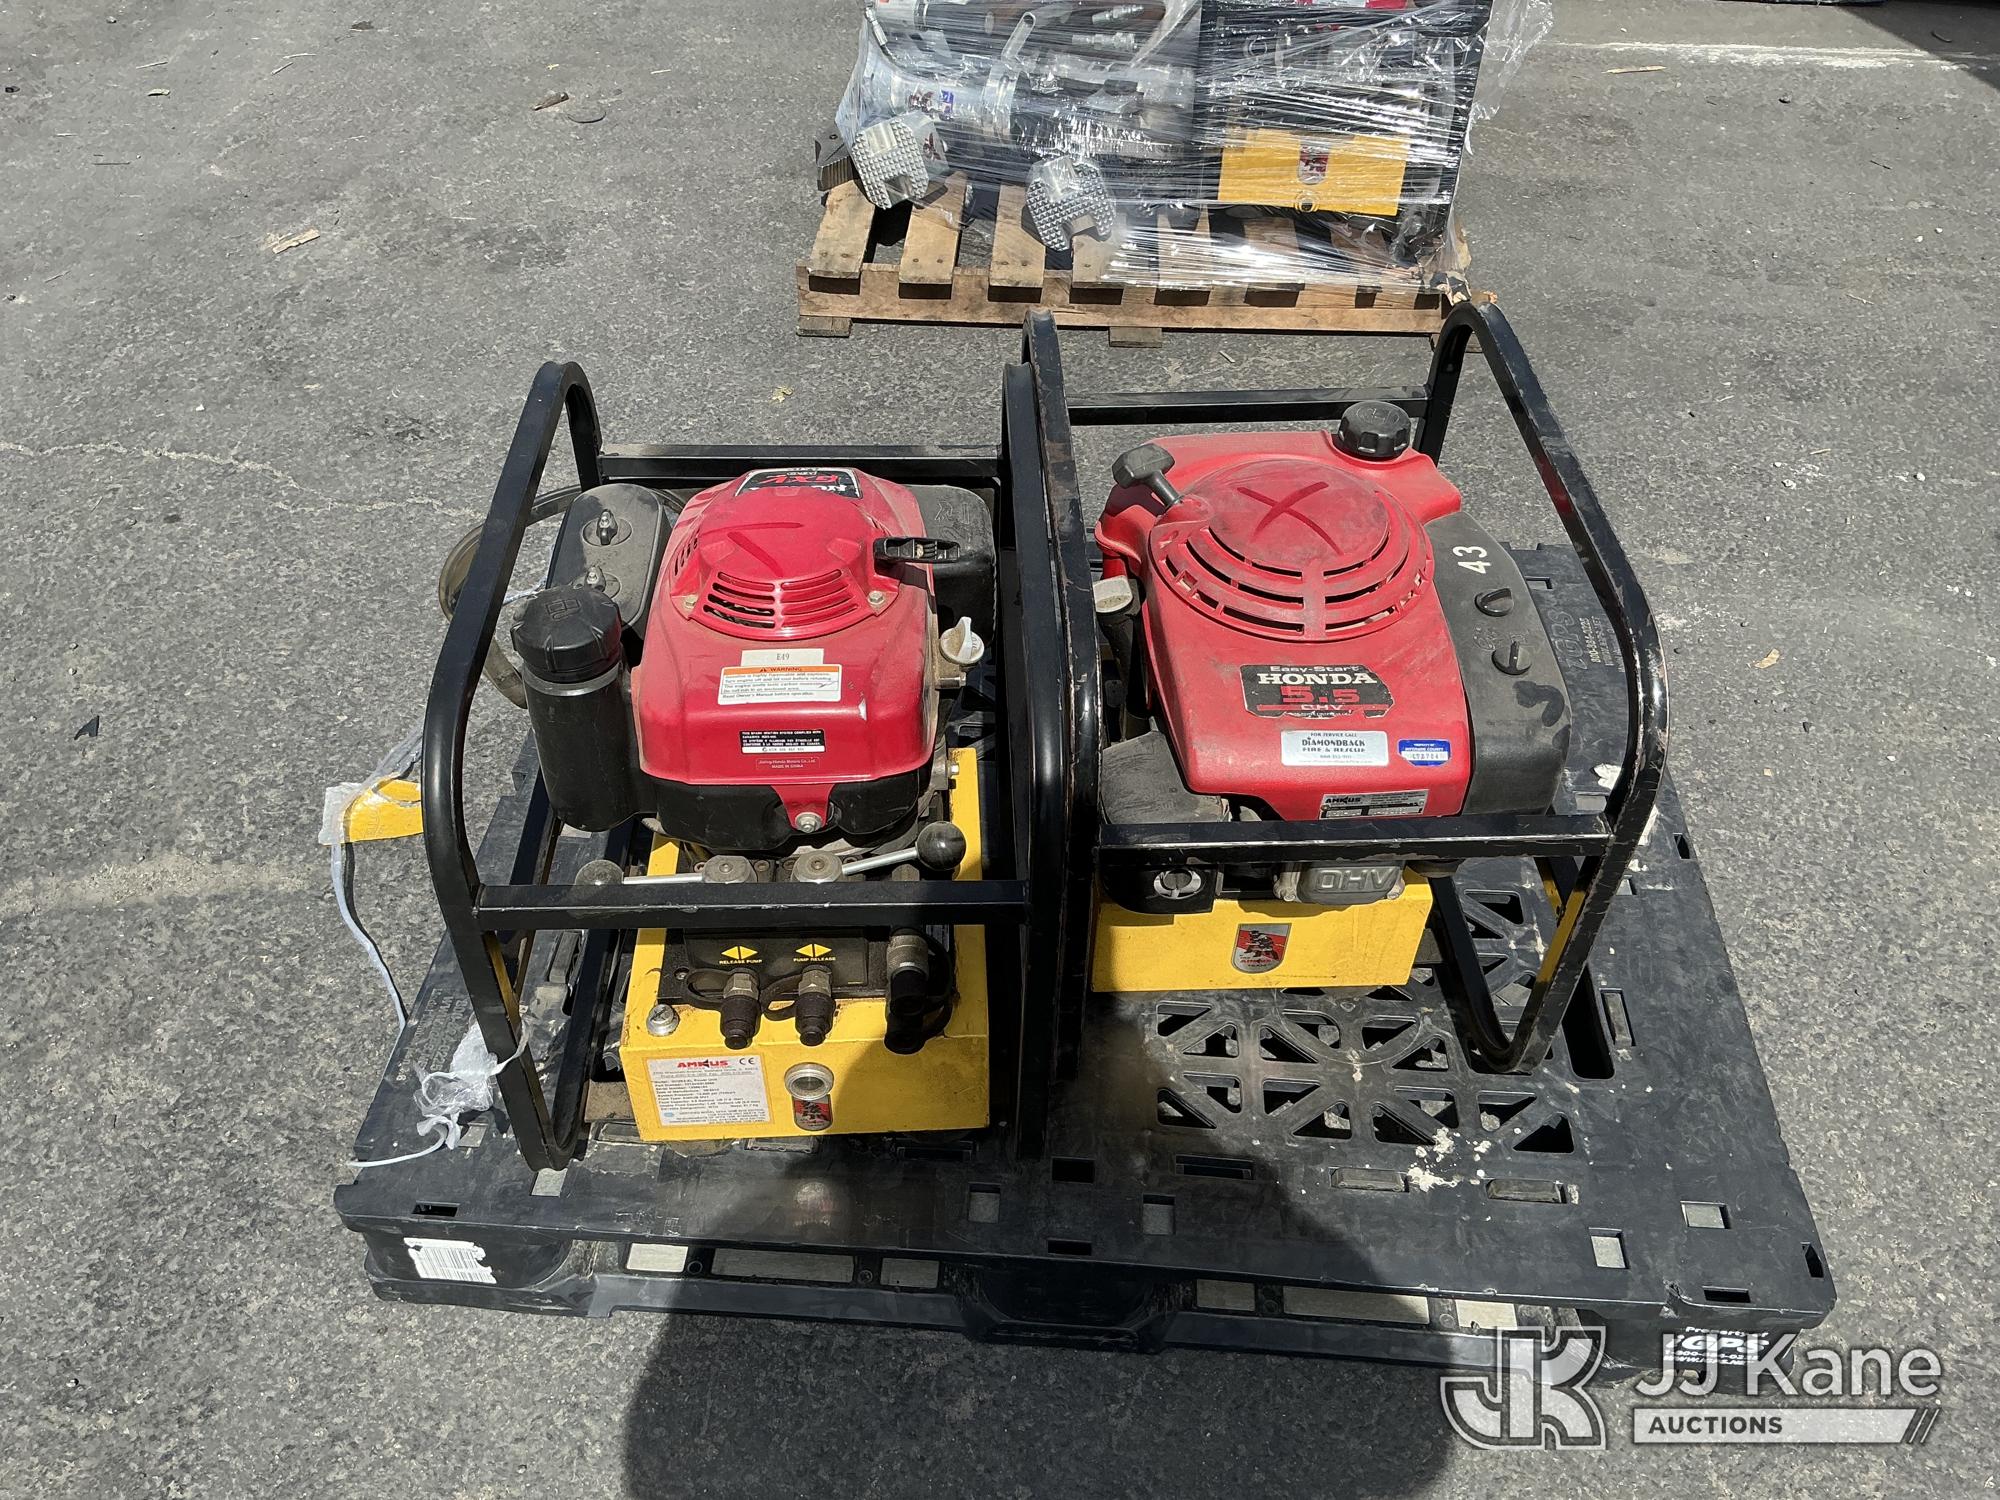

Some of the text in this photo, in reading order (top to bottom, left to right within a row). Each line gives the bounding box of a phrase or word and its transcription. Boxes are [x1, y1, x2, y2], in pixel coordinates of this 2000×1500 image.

[1453, 546, 1492, 574] 43
[1269, 665, 1360, 673] Easy-Start
[1256, 673, 1378, 685] HONDA
[1280, 685, 1360, 703] 5.5
[1316, 867, 1395, 892] OHV
[677, 1059, 729, 1068] AMKUS
